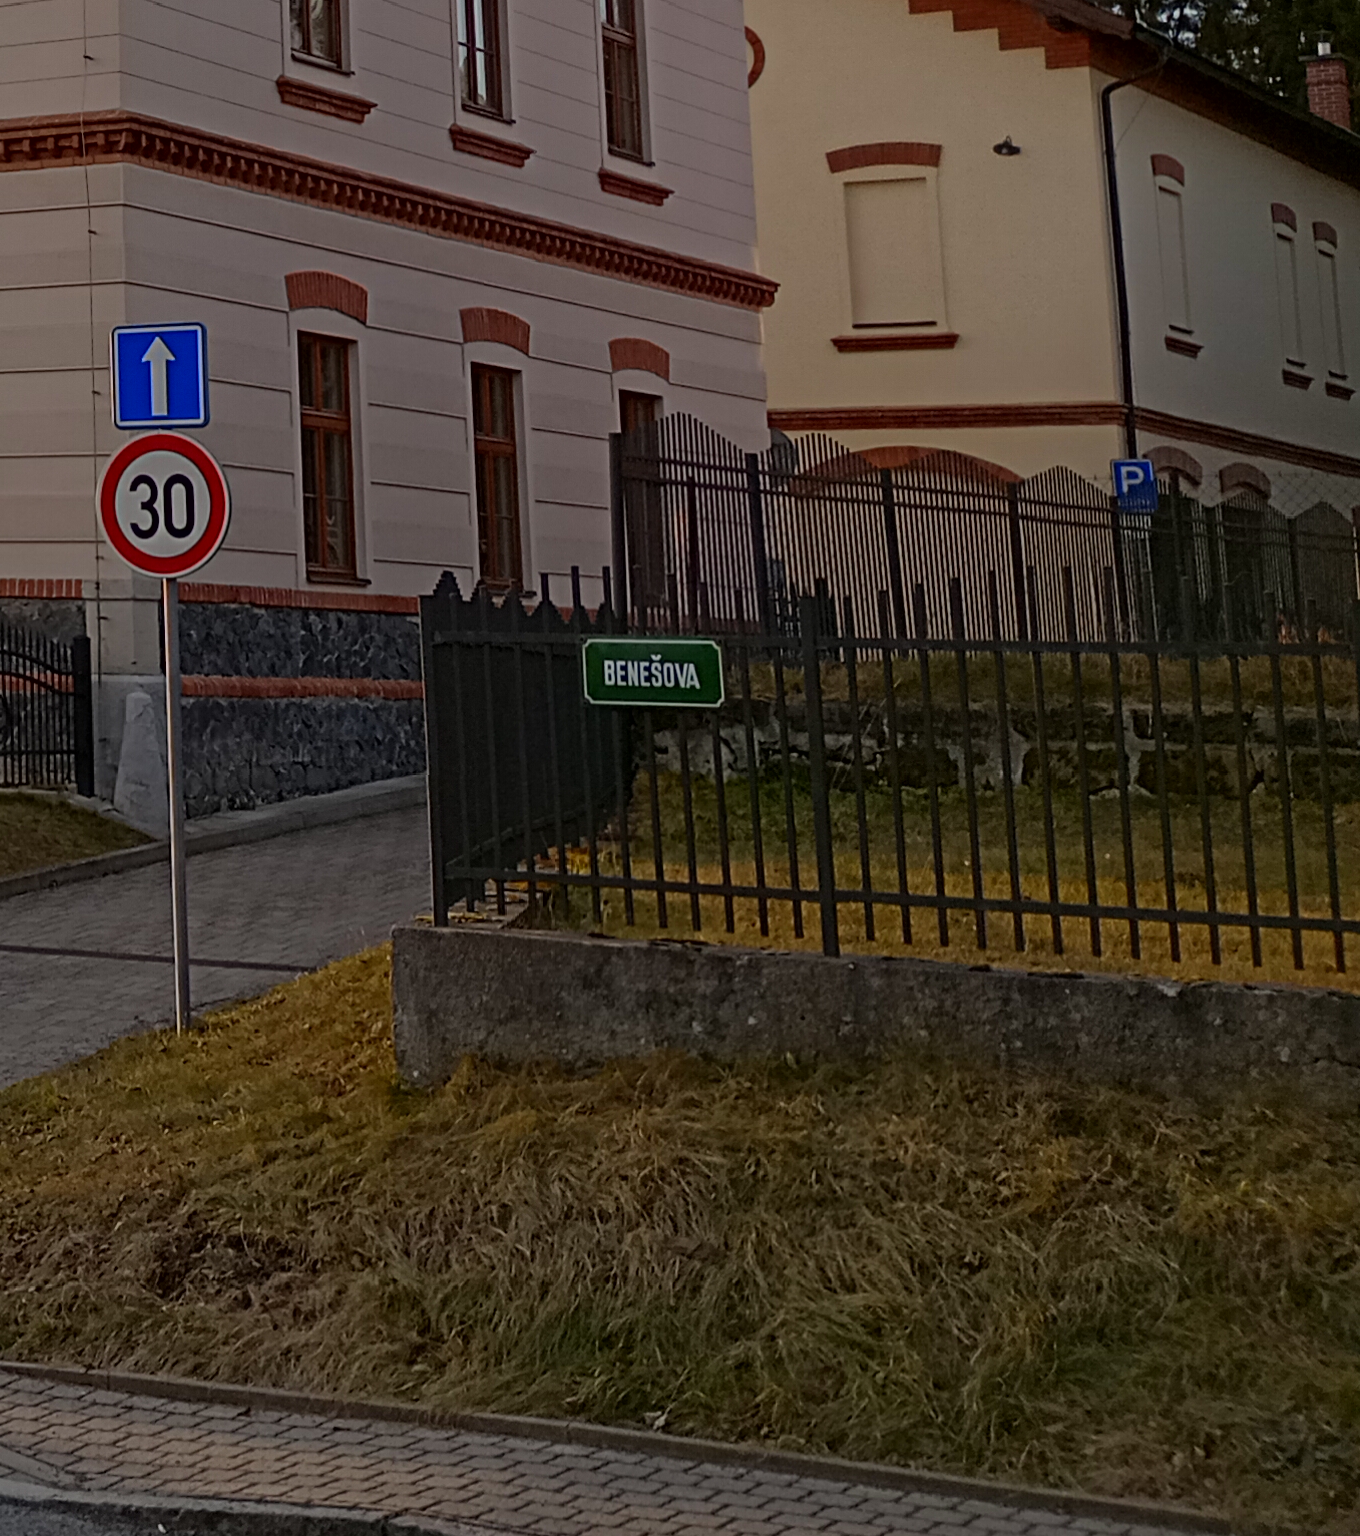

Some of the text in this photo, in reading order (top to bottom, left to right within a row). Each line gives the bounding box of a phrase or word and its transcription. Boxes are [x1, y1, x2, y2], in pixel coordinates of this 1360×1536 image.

[1120, 465, 1144, 493] P
[129, 473, 195, 540] 30
[603, 653, 701, 690] BENEŠOVA
